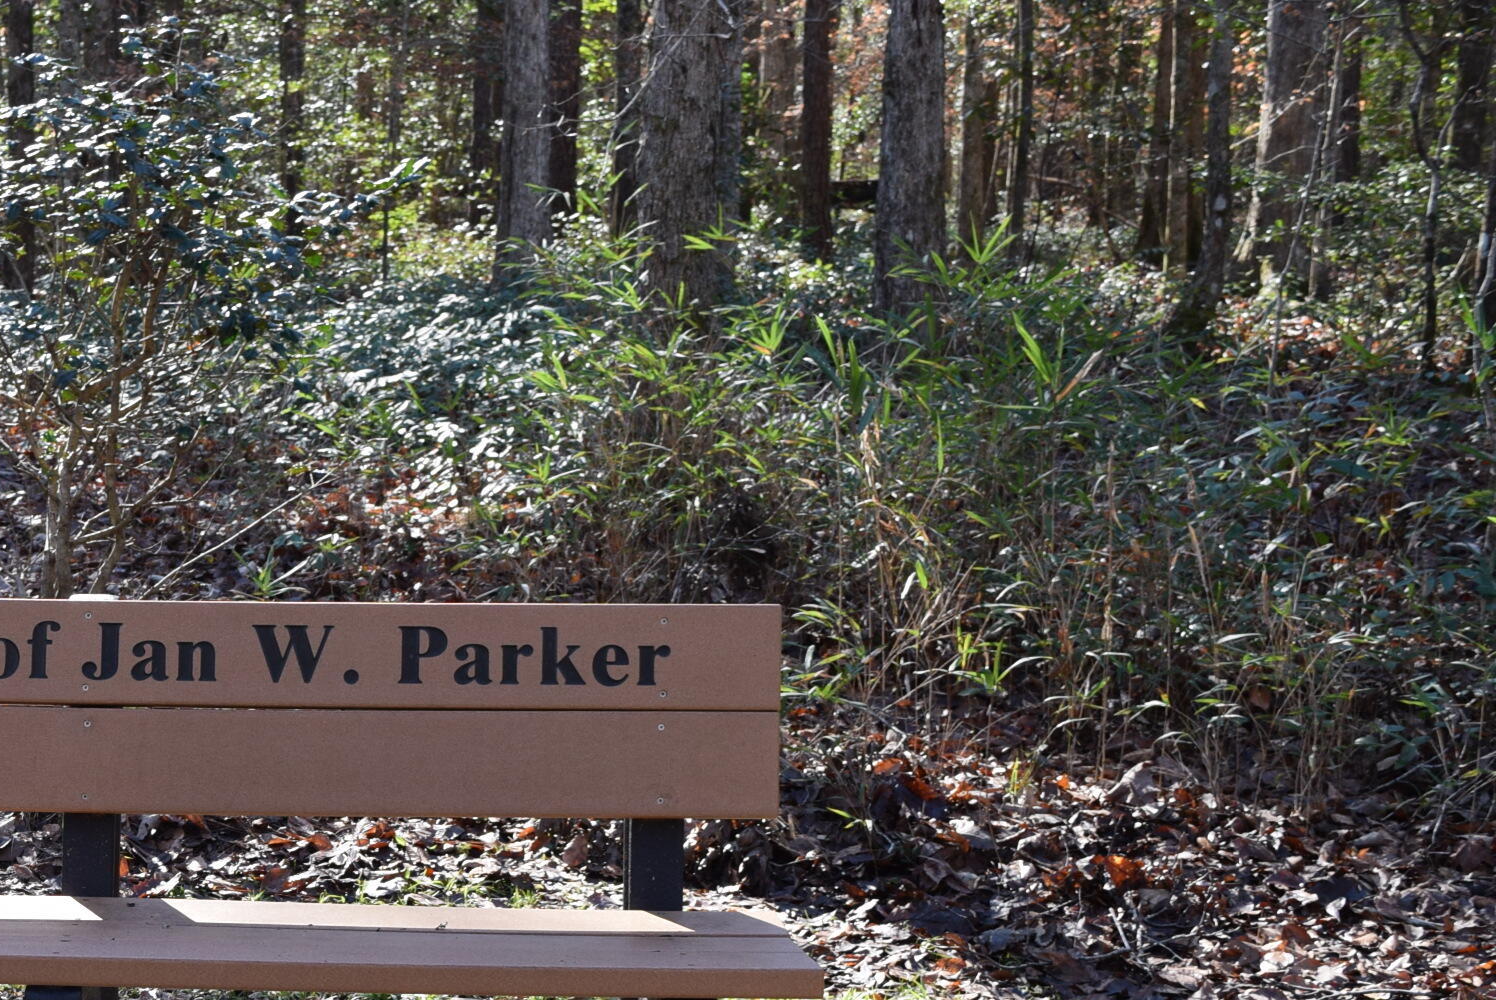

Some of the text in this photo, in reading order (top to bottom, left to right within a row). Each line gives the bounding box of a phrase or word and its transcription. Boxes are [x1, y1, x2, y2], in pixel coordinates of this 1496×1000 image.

[81, 622, 217, 683] Jan
[251, 624, 361, 686] W.
[397, 625, 673, 687] Parker
